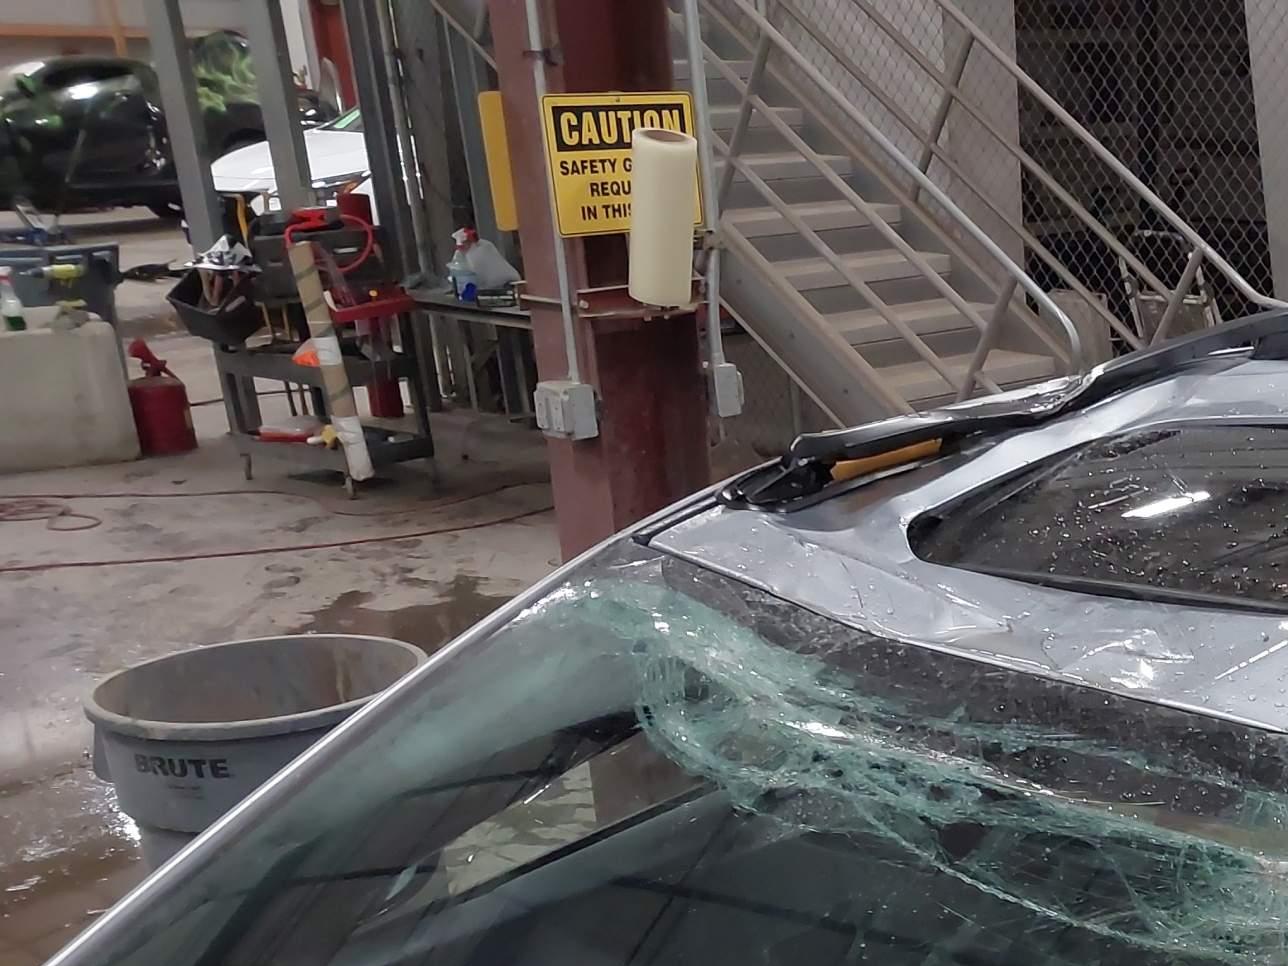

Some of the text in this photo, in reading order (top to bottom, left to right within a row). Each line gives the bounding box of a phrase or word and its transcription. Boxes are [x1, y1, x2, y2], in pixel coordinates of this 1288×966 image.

[560, 109, 680, 145] CAUTION
[560, 158, 617, 176] SAFETY
[581, 205, 598, 221] IN
[134, 754, 231, 778] BRUTE
